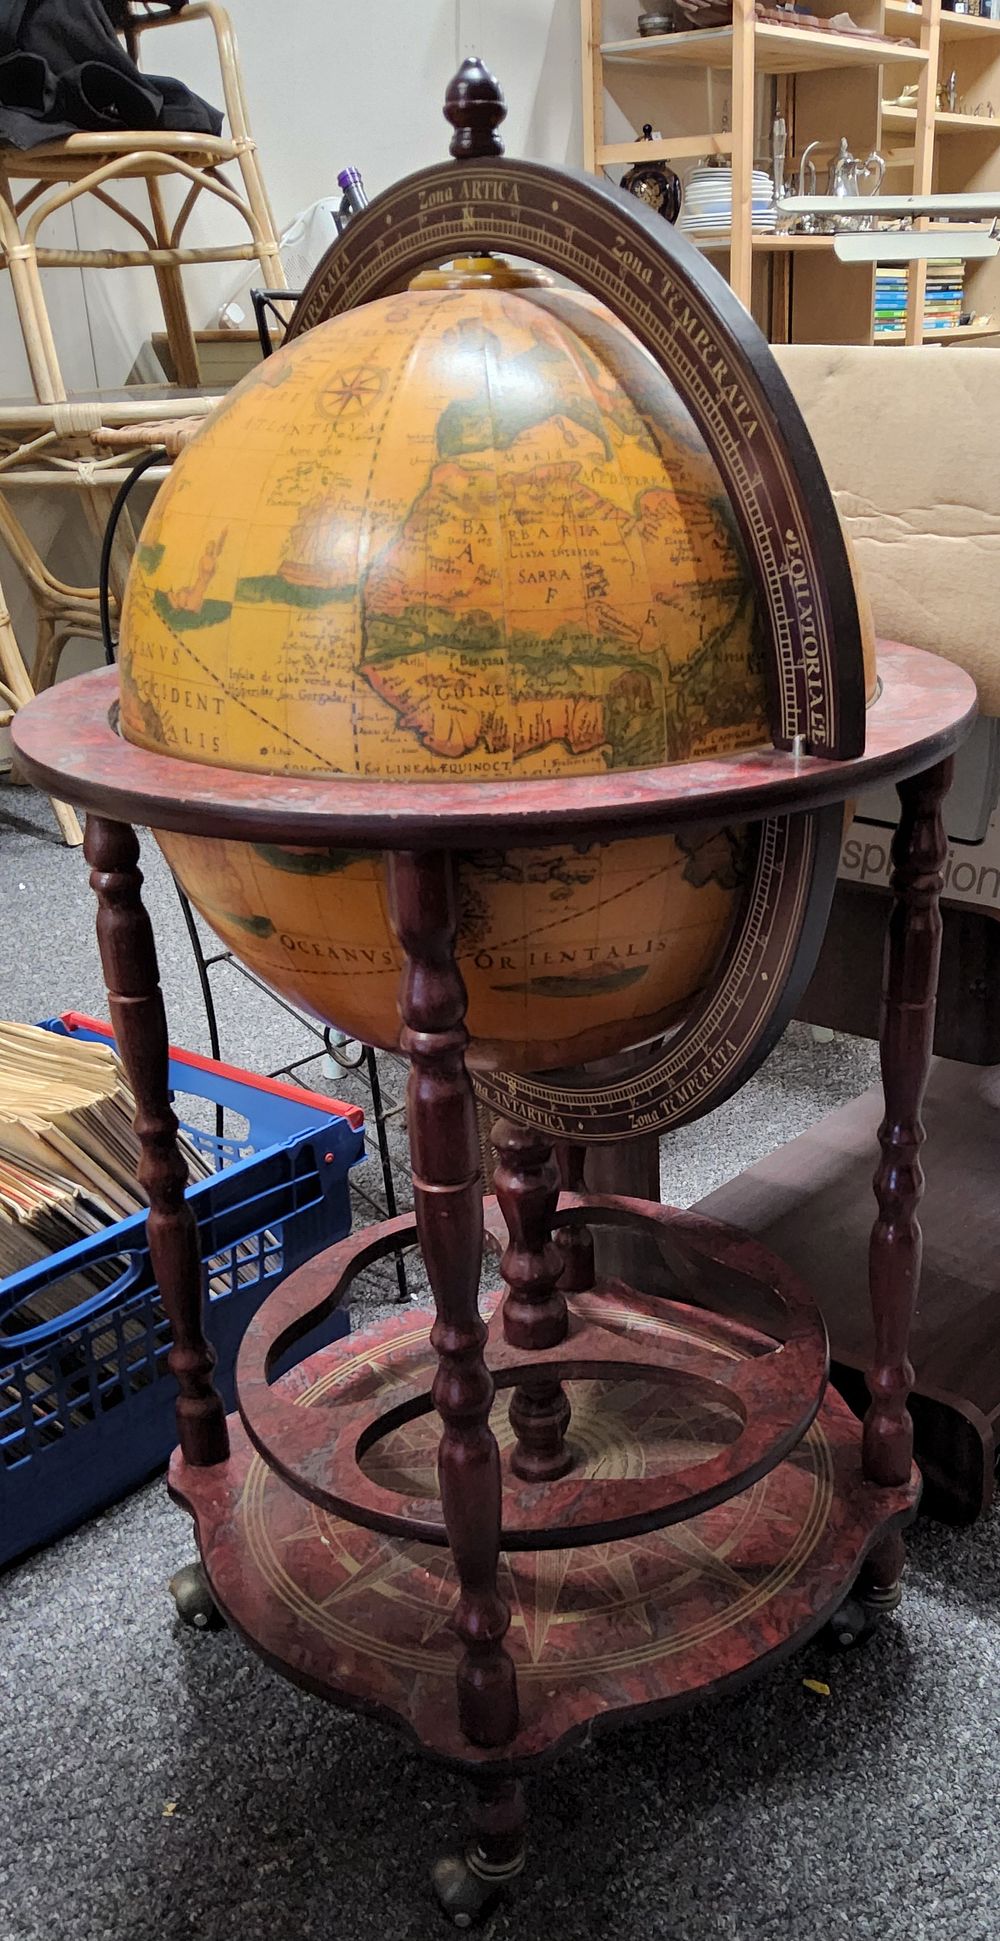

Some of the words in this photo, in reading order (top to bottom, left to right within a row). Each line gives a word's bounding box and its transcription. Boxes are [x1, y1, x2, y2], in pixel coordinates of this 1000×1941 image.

[418, 187, 453, 210] Zona
[459, 180, 521, 202] ARTICA
[611, 236, 655, 284] Zona
[660, 274, 760, 439] TEMPERATA
[279, 934, 394, 966] OCEANVS
[627, 1112, 660, 1130] Zona
[659, 1038, 738, 1124] TEMPERATA
[493, 1091, 566, 1131] ANTARTICA
